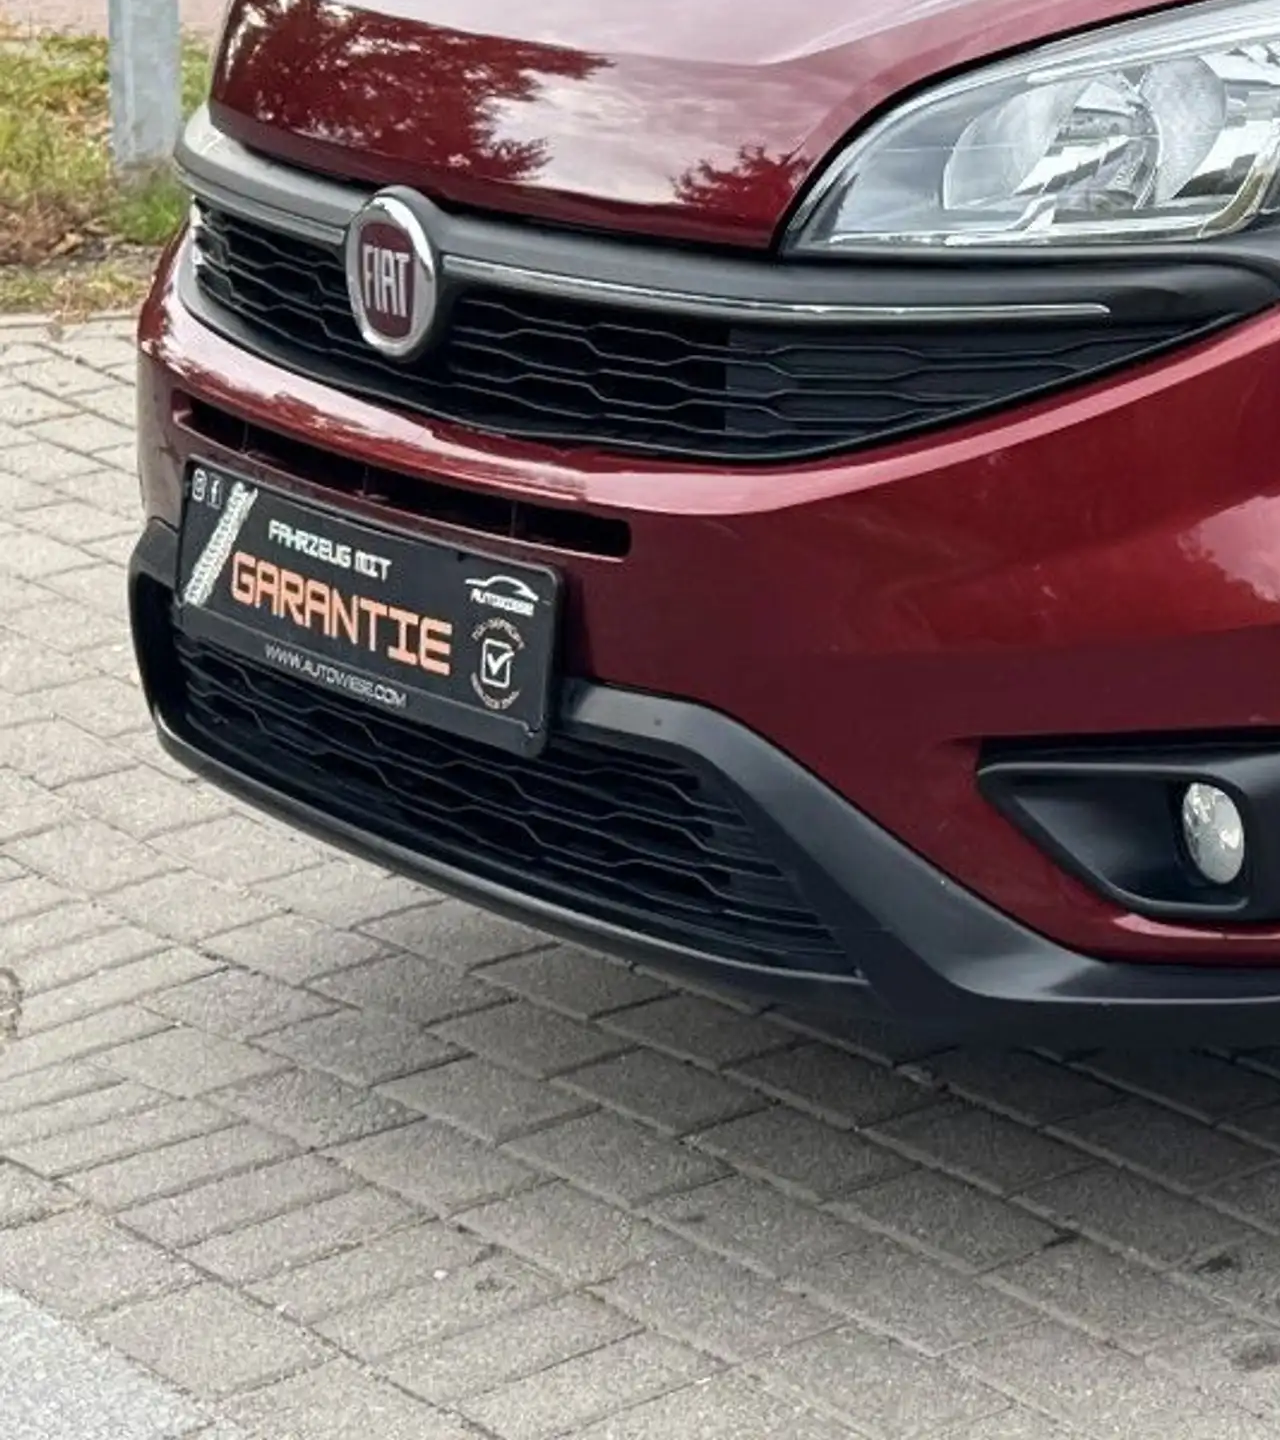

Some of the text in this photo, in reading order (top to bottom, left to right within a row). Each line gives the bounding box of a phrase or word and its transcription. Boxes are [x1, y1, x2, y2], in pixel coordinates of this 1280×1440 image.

[362, 243, 409, 318] FIAT
[268, 520, 392, 581] FAHRZEUG MIT
[231, 551, 453, 676] GARANTIE
